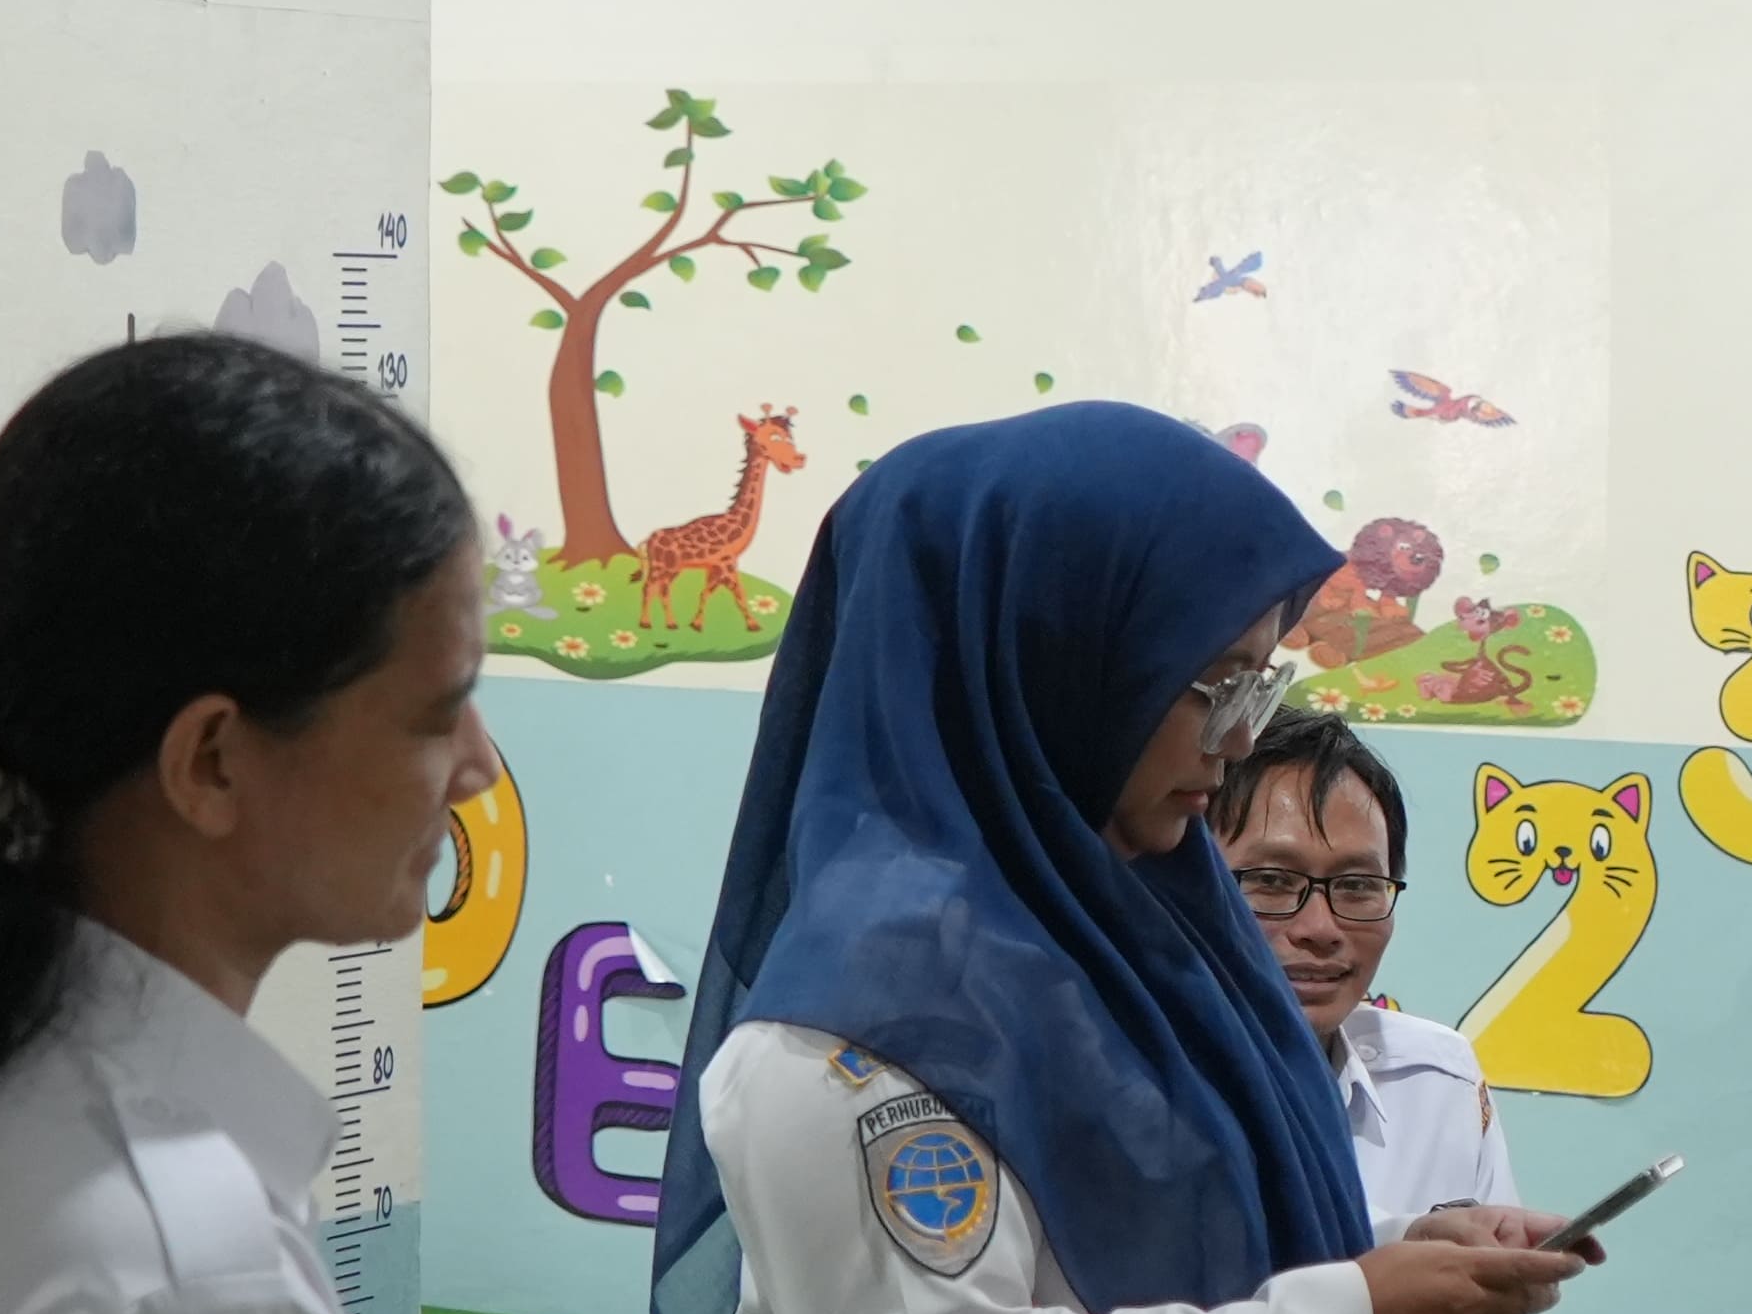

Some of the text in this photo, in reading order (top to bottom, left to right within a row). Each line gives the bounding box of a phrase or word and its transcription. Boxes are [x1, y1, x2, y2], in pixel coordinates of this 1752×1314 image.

[377, 211, 408, 249] 140
[377, 351, 408, 390] 130
[1455, 761, 1660, 1099] 2
[372, 1045, 395, 1085] 80
[373, 1185, 393, 1222] 70
